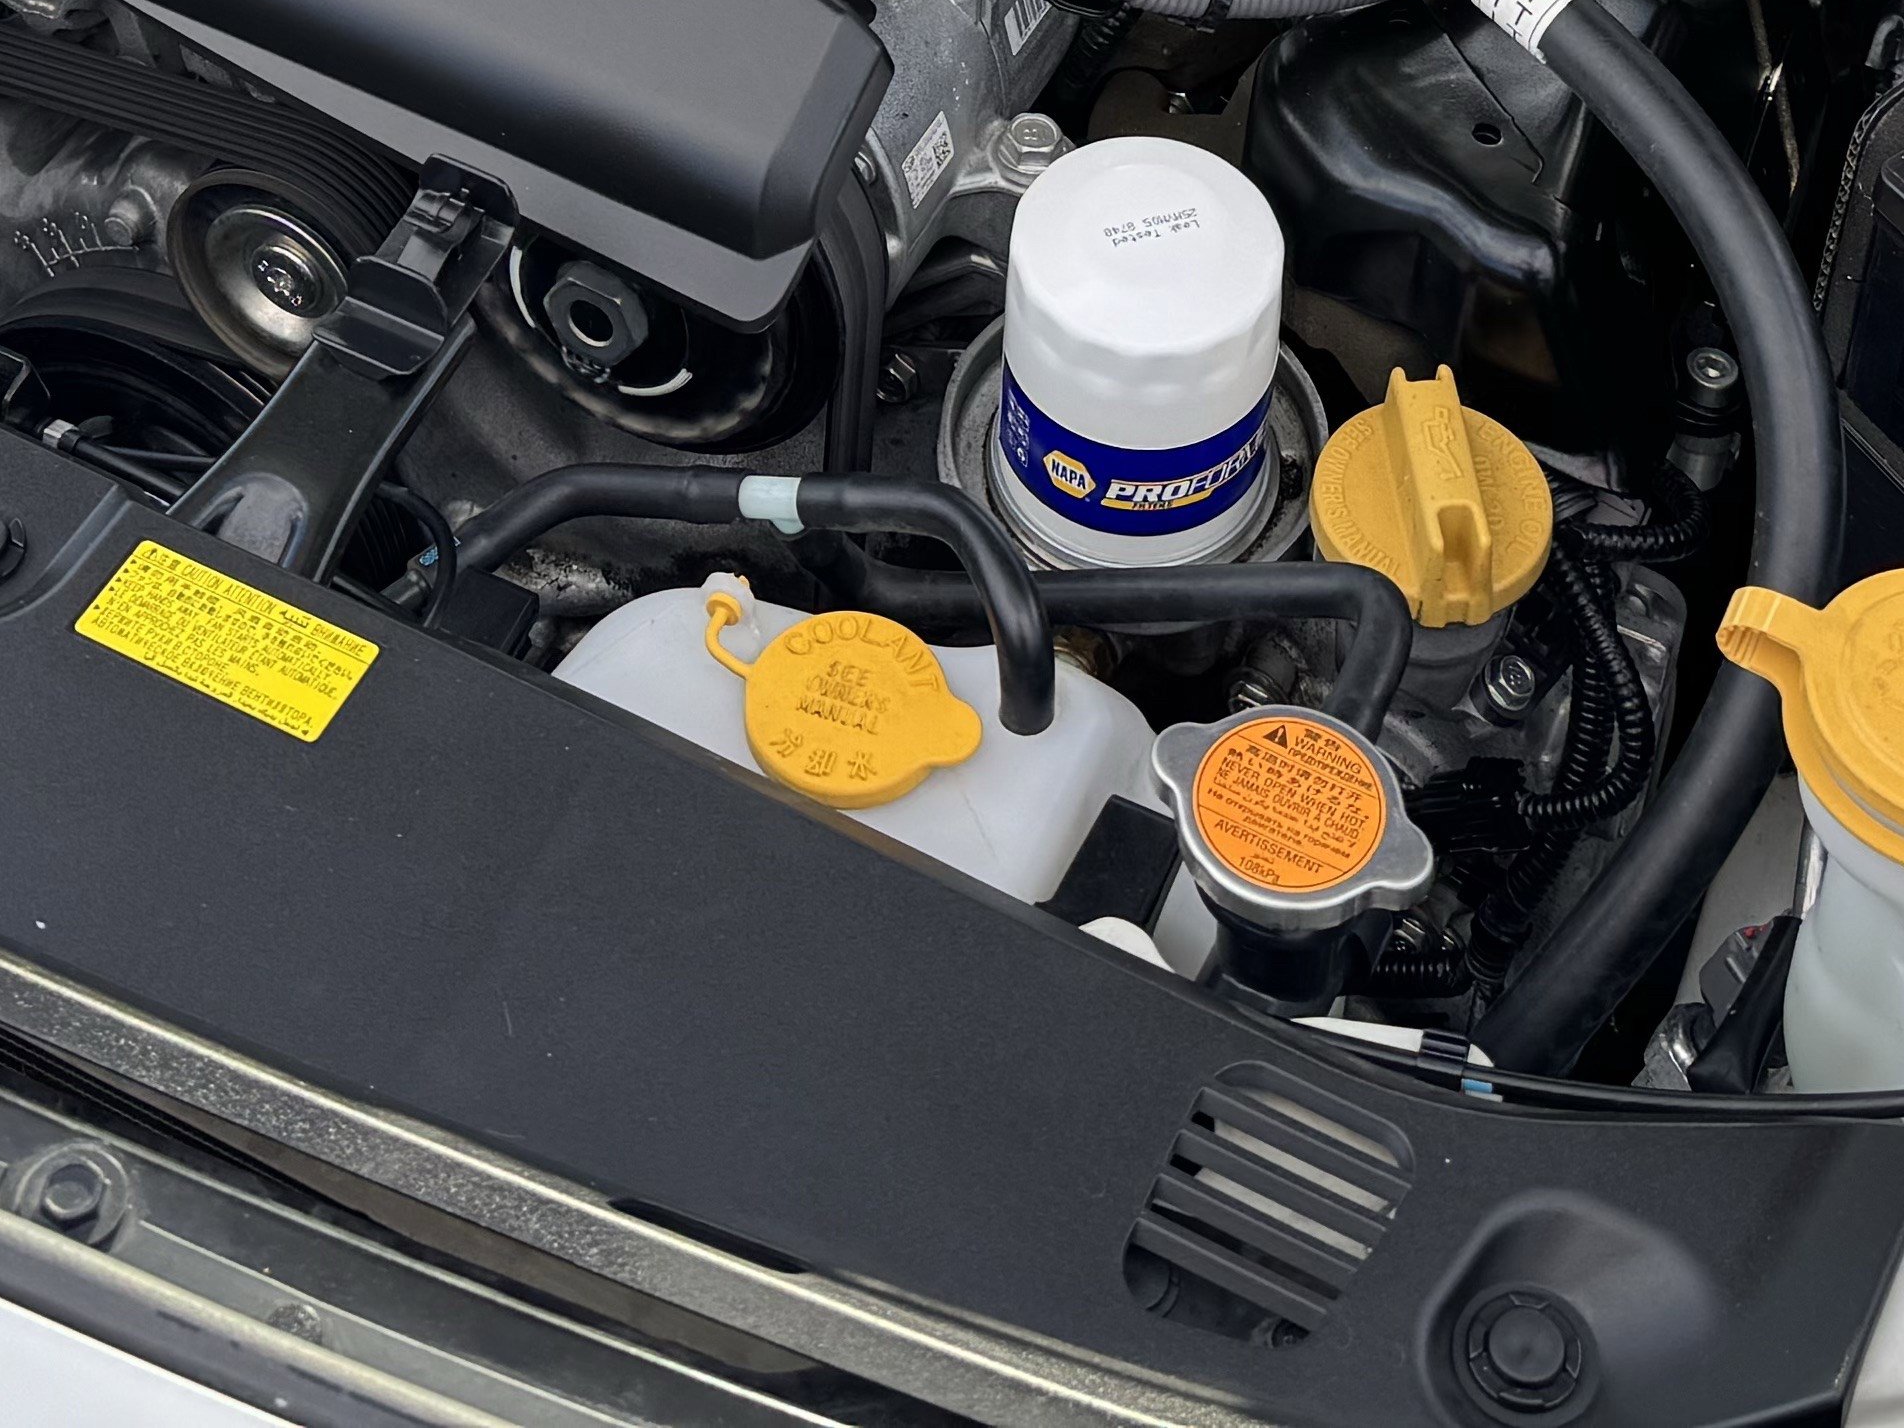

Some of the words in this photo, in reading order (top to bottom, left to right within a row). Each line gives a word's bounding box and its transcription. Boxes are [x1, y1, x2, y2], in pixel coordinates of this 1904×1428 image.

[1349, 419, 1374, 454] SEE
[1050, 457, 1086, 491] NAPA
[1477, 419, 1549, 511] ENGINE
[1506, 520, 1544, 556] OIL
[181, 564, 224, 590] CAUTION
[223, 584, 277, 615] ATTENTION
[225, 627, 260, 649] STARTS
[784, 614, 941, 693] COOLANT
[826, 660, 871, 688] SEE
[795, 694, 880, 736] MANUAL
[1295, 736, 1362, 774] WARNING
[1215, 766, 1231, 781] NE
[1232, 776, 1270, 799] JAMAIS
[1272, 793, 1311, 817] OUVRIR
[1220, 757, 1260, 781] NEVER
[1263, 777, 1297, 798] OPEN
[1300, 793, 1337, 817] WHEN
[1215, 819, 1322, 872] AVERTISSEMENT
